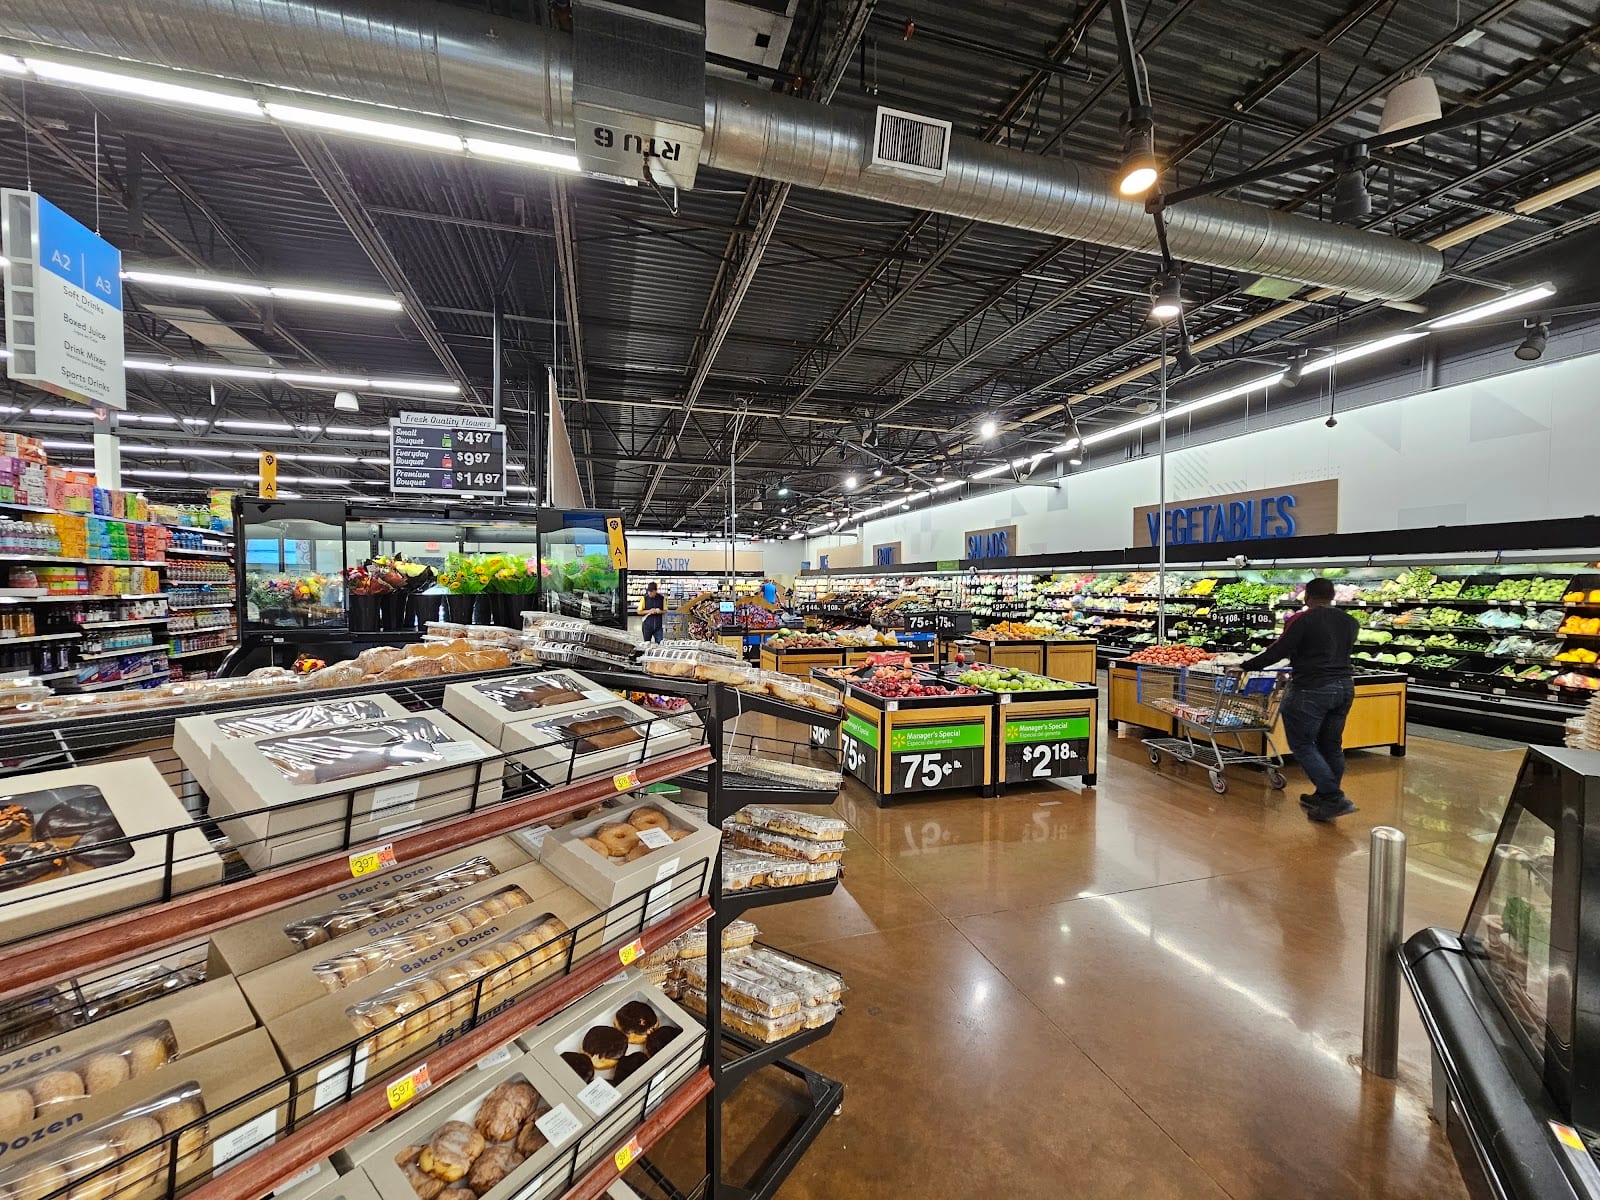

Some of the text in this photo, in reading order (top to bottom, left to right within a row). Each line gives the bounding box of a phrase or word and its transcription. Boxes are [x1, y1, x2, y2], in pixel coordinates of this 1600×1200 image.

[624, 134, 681, 161] RTU
[52, 249, 112, 295] A2 A3
[63, 285, 80, 302] Soft
[81, 295, 105, 315] Drinks
[63, 312, 87, 331] Boxed
[88, 326, 107, 340] Juice
[64, 340, 85, 356] Drink
[86, 351, 107, 366] Mixes
[61, 366, 87, 383] Sports
[87, 376, 111, 392] Drinks
[405, 414, 492, 427] Fresh Quality Flowers
[395, 428, 417, 436] Small
[457, 431, 491, 445] $497
[395, 436, 424, 445] Bouquet
[395, 448, 429, 459] Everyday
[395, 456, 424, 466] Bouquet
[457, 452, 491, 465] $997
[395, 470, 430, 478] Premium
[456, 472, 500, 486] $1497
[395, 478, 426, 487] Bouquet
[1147, 495, 1297, 547] VEGETABLES
[967, 530, 1008, 560] SALADS
[656, 557, 690, 571] PASTRY
[1019, 722, 1068, 734] Manager's Special
[906, 730, 961, 742] Manager's Special
[354, 856, 374, 873] 397
[337, 865, 433, 901] Baker's Dozen
[367, 894, 465, 937] Baker's Dozen
[400, 925, 499, 974] Baker's Dozen
[392, 1080, 410, 1102] 597
